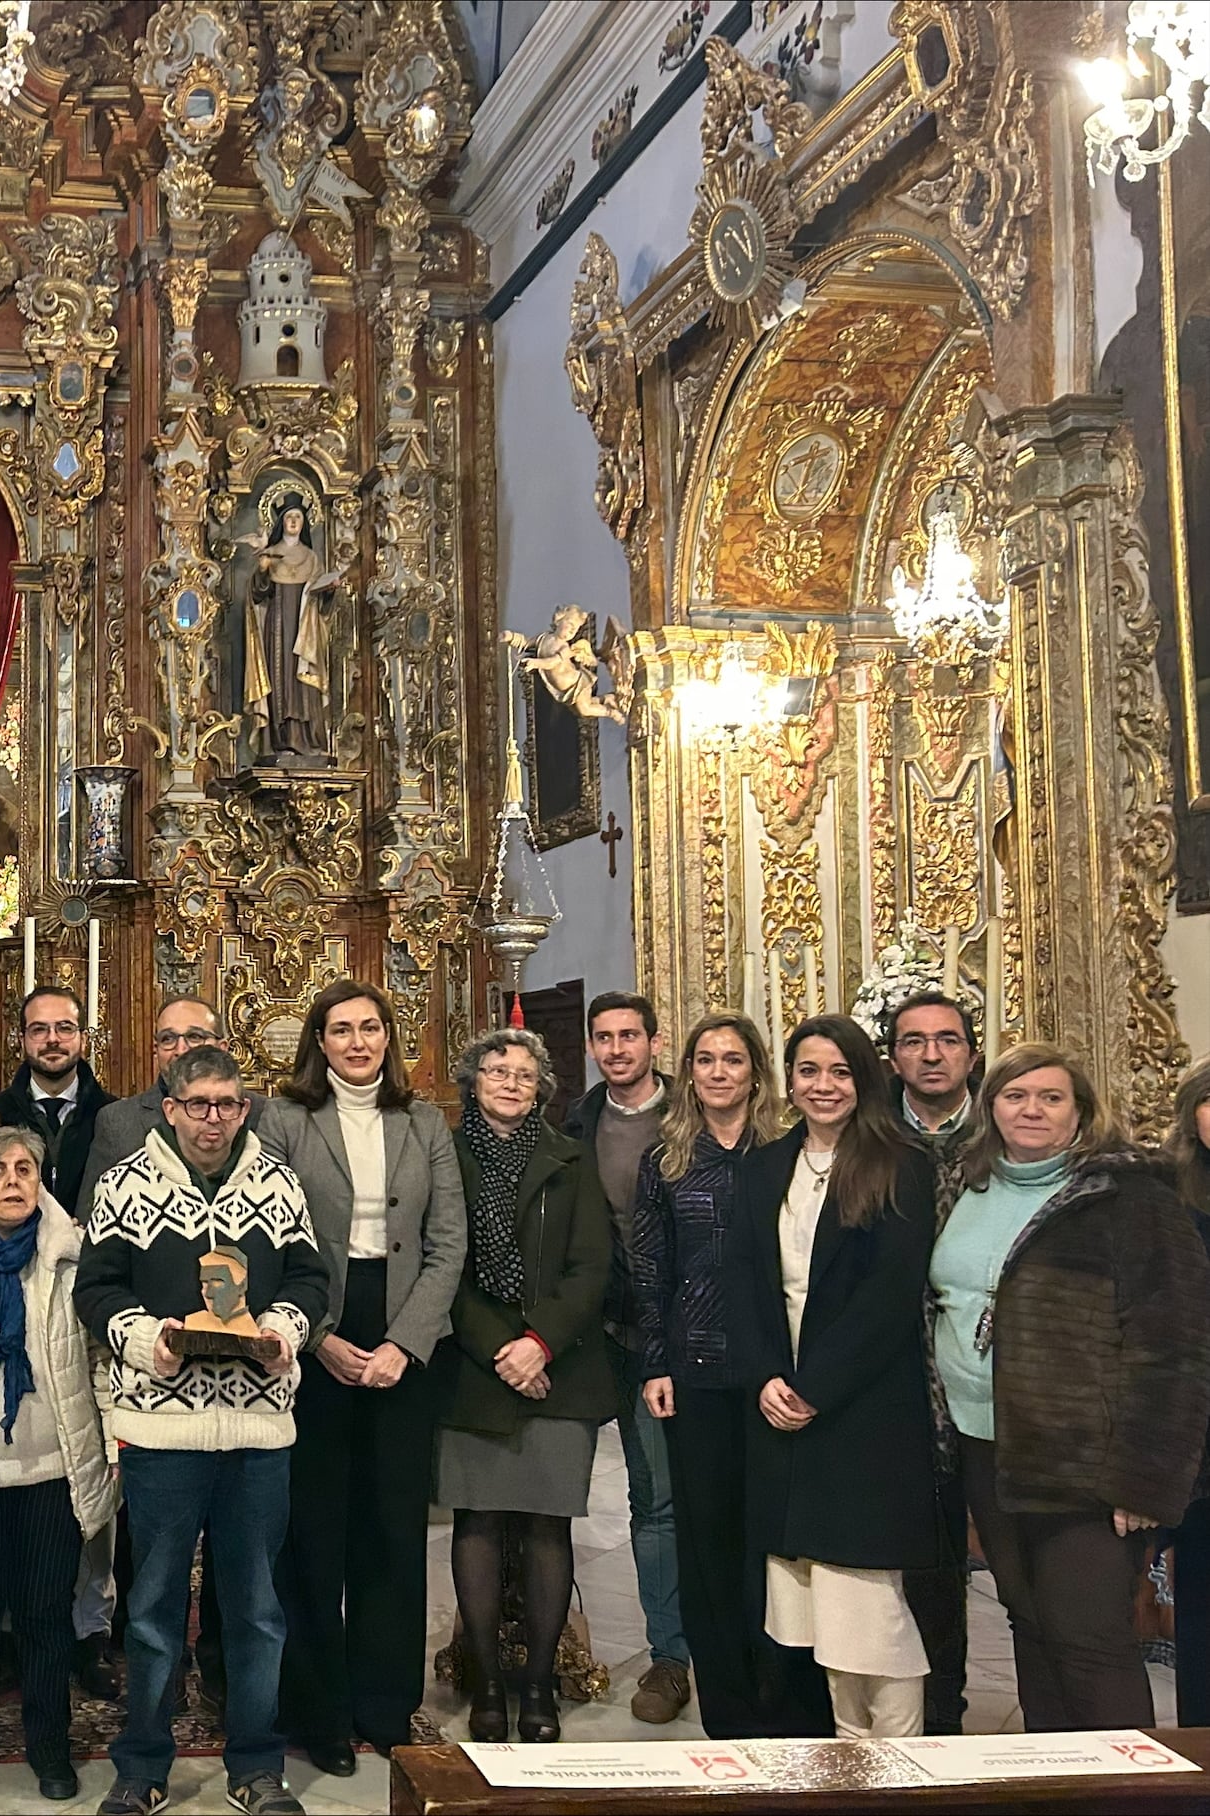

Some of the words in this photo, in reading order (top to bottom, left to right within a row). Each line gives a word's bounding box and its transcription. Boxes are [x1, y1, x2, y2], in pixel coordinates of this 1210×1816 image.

[983, 1757, 1045, 1766] CASTILLO
[1046, 1756, 1102, 1764] JACINTO
[590, 1769, 633, 1778] BLASA
[635, 1769, 681, 1778] MARÍA
